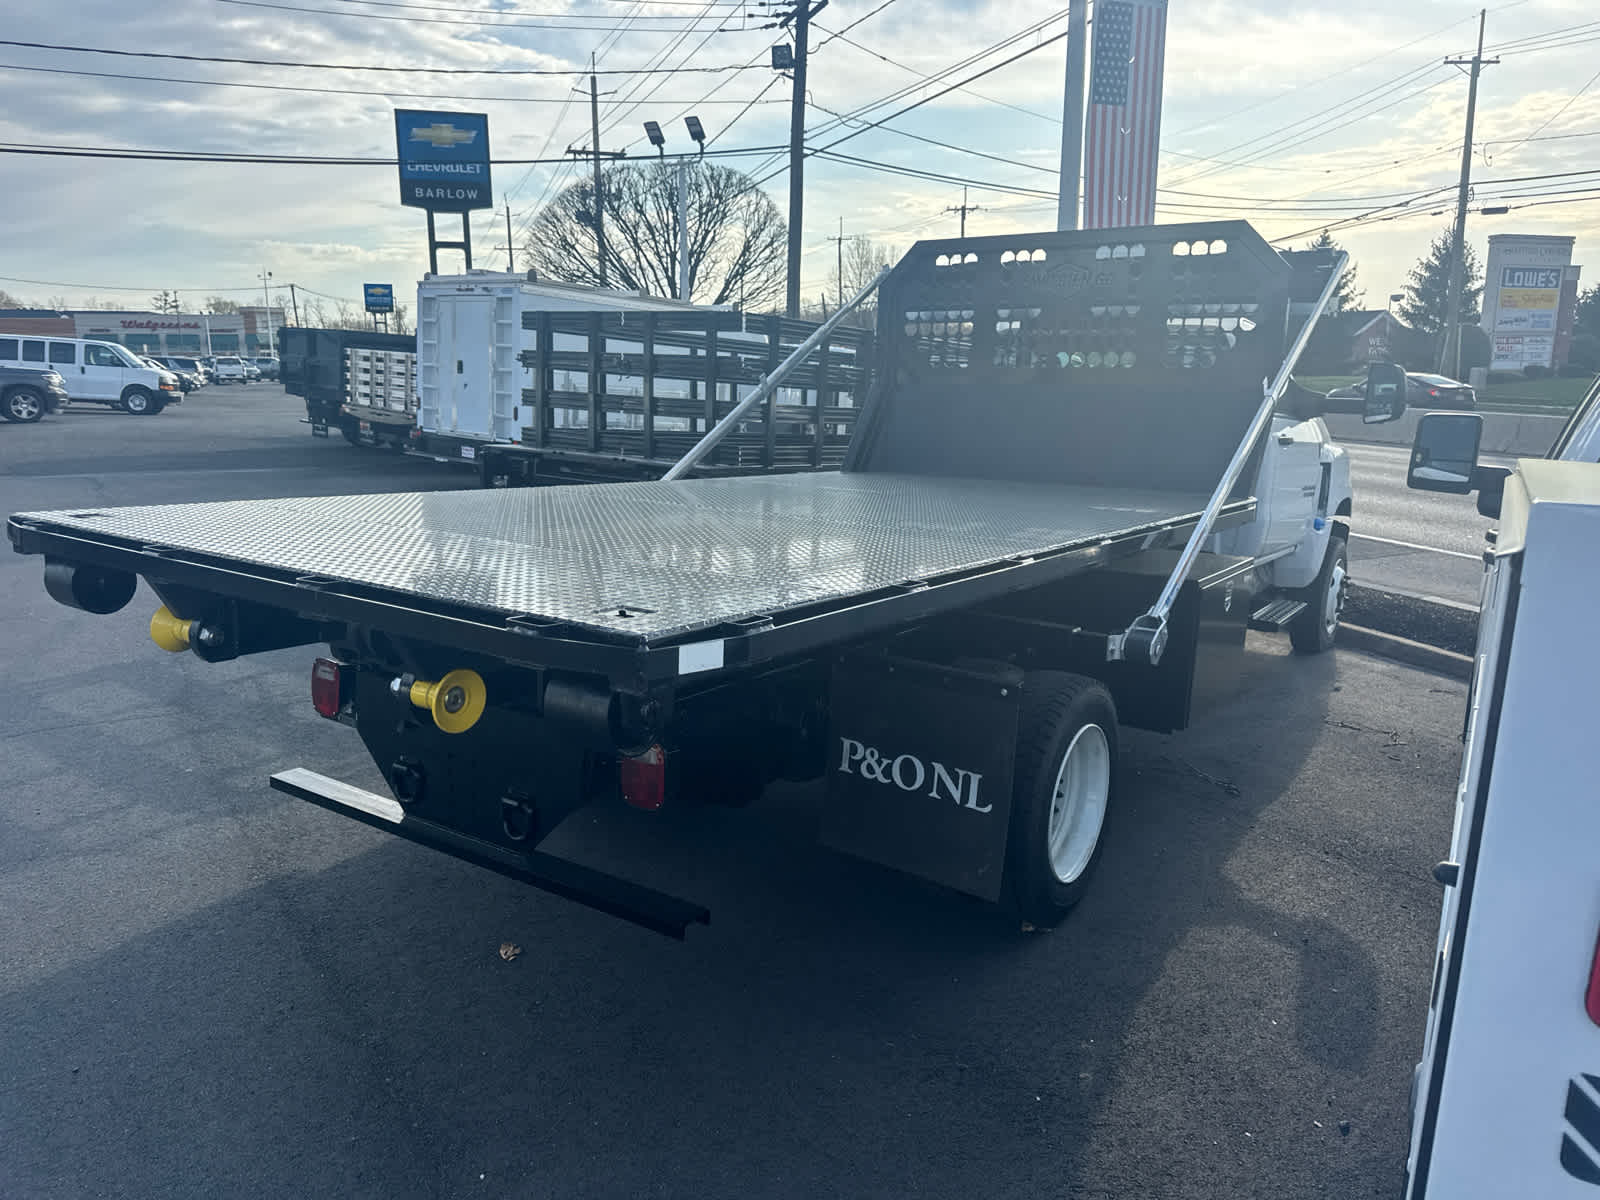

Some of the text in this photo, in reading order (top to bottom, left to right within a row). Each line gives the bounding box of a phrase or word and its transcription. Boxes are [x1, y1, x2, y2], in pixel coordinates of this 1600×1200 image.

[407, 160, 481, 174] CHEVROLET
[415, 187, 478, 199] BARLOW
[1504, 268, 1557, 287] LOWE'S
[120, 319, 200, 331] Walgreens
